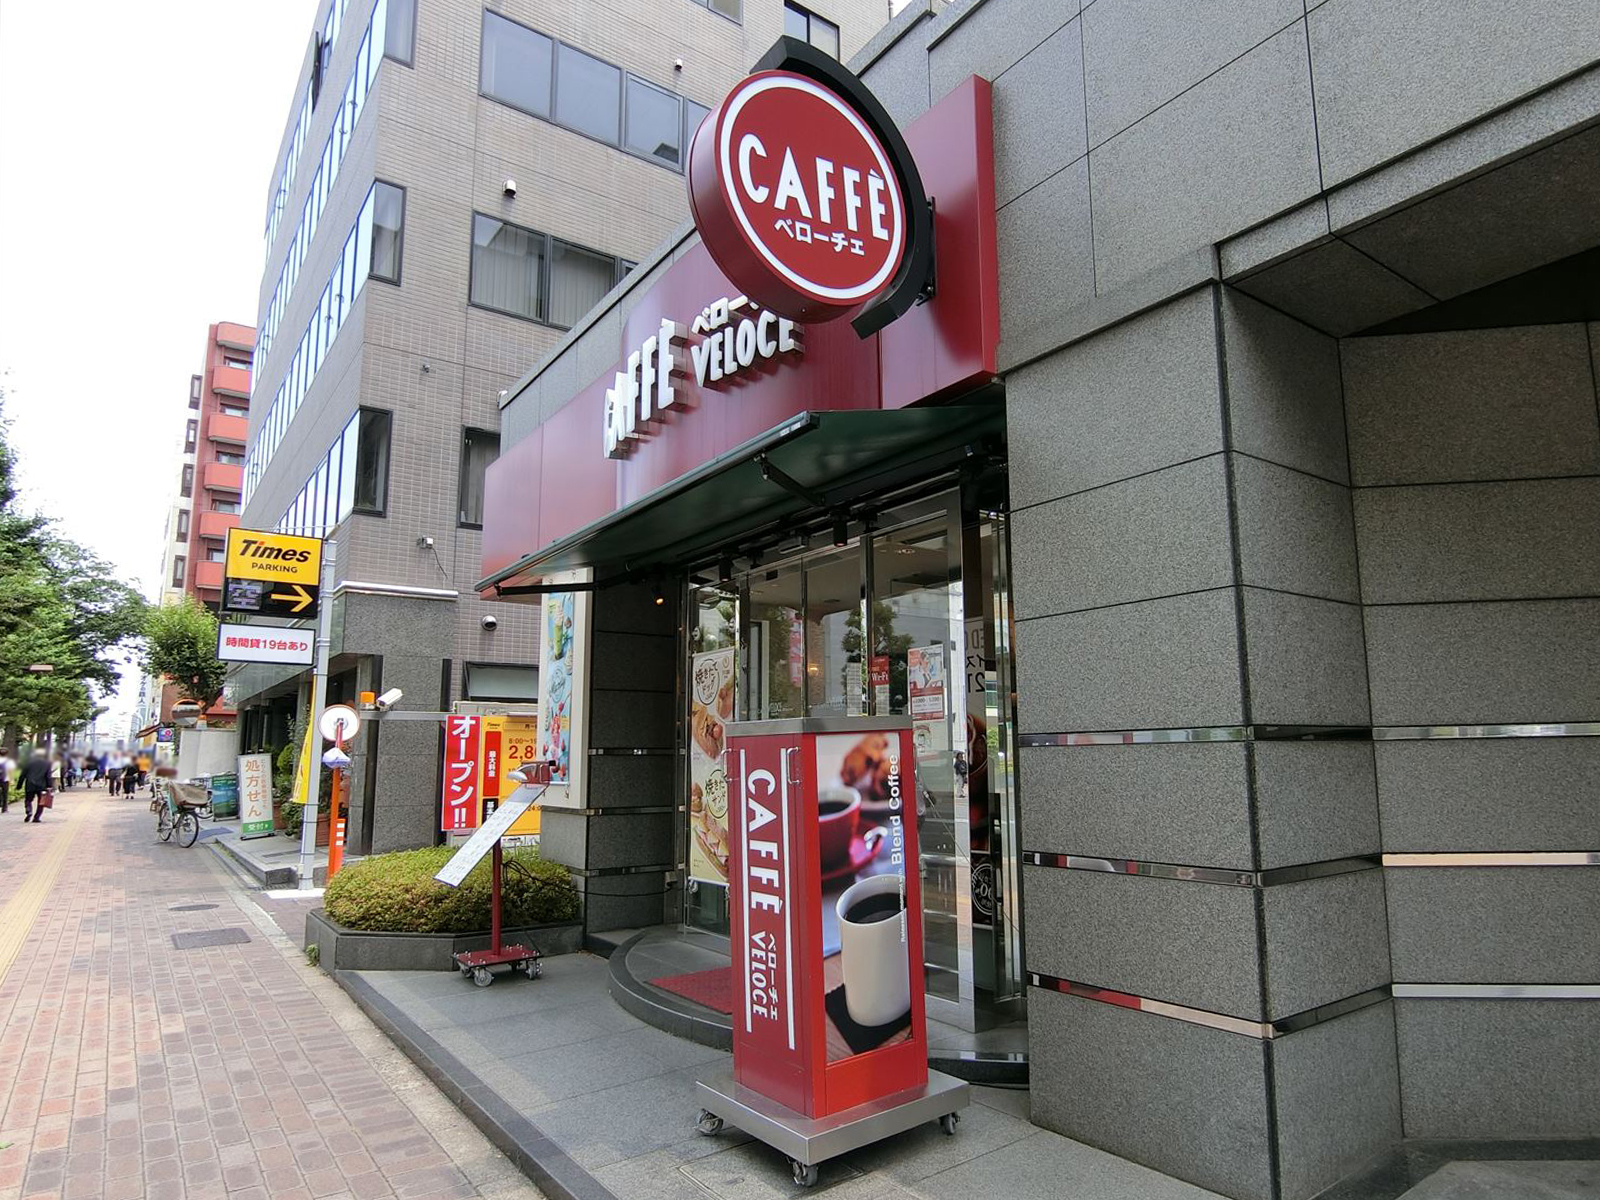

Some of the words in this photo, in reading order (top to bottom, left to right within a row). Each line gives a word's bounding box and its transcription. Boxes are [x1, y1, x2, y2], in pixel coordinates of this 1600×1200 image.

[738, 133, 889, 240] CAFFÈ
[774, 218, 865, 256] ベローチェ
[691, 294, 759, 334] ベロー
[690, 309, 796, 388] VELOCE
[239, 539, 311, 563] Times
[251, 562, 298, 574] PARKING
[225, 636, 308, 652] 時間貸19台あり
[871, 671, 889, 682] Wi-Fi
[450, 715, 476, 828] オープン!!
[508, 745, 537, 761] 2,8
[245, 759, 262, 818] 処方せん
[889, 755, 899, 811] Coffee
[747, 769, 784, 914] CAFFÈ
[891, 814, 902, 866] Blend
[751, 931, 768, 1018] VELOCE
